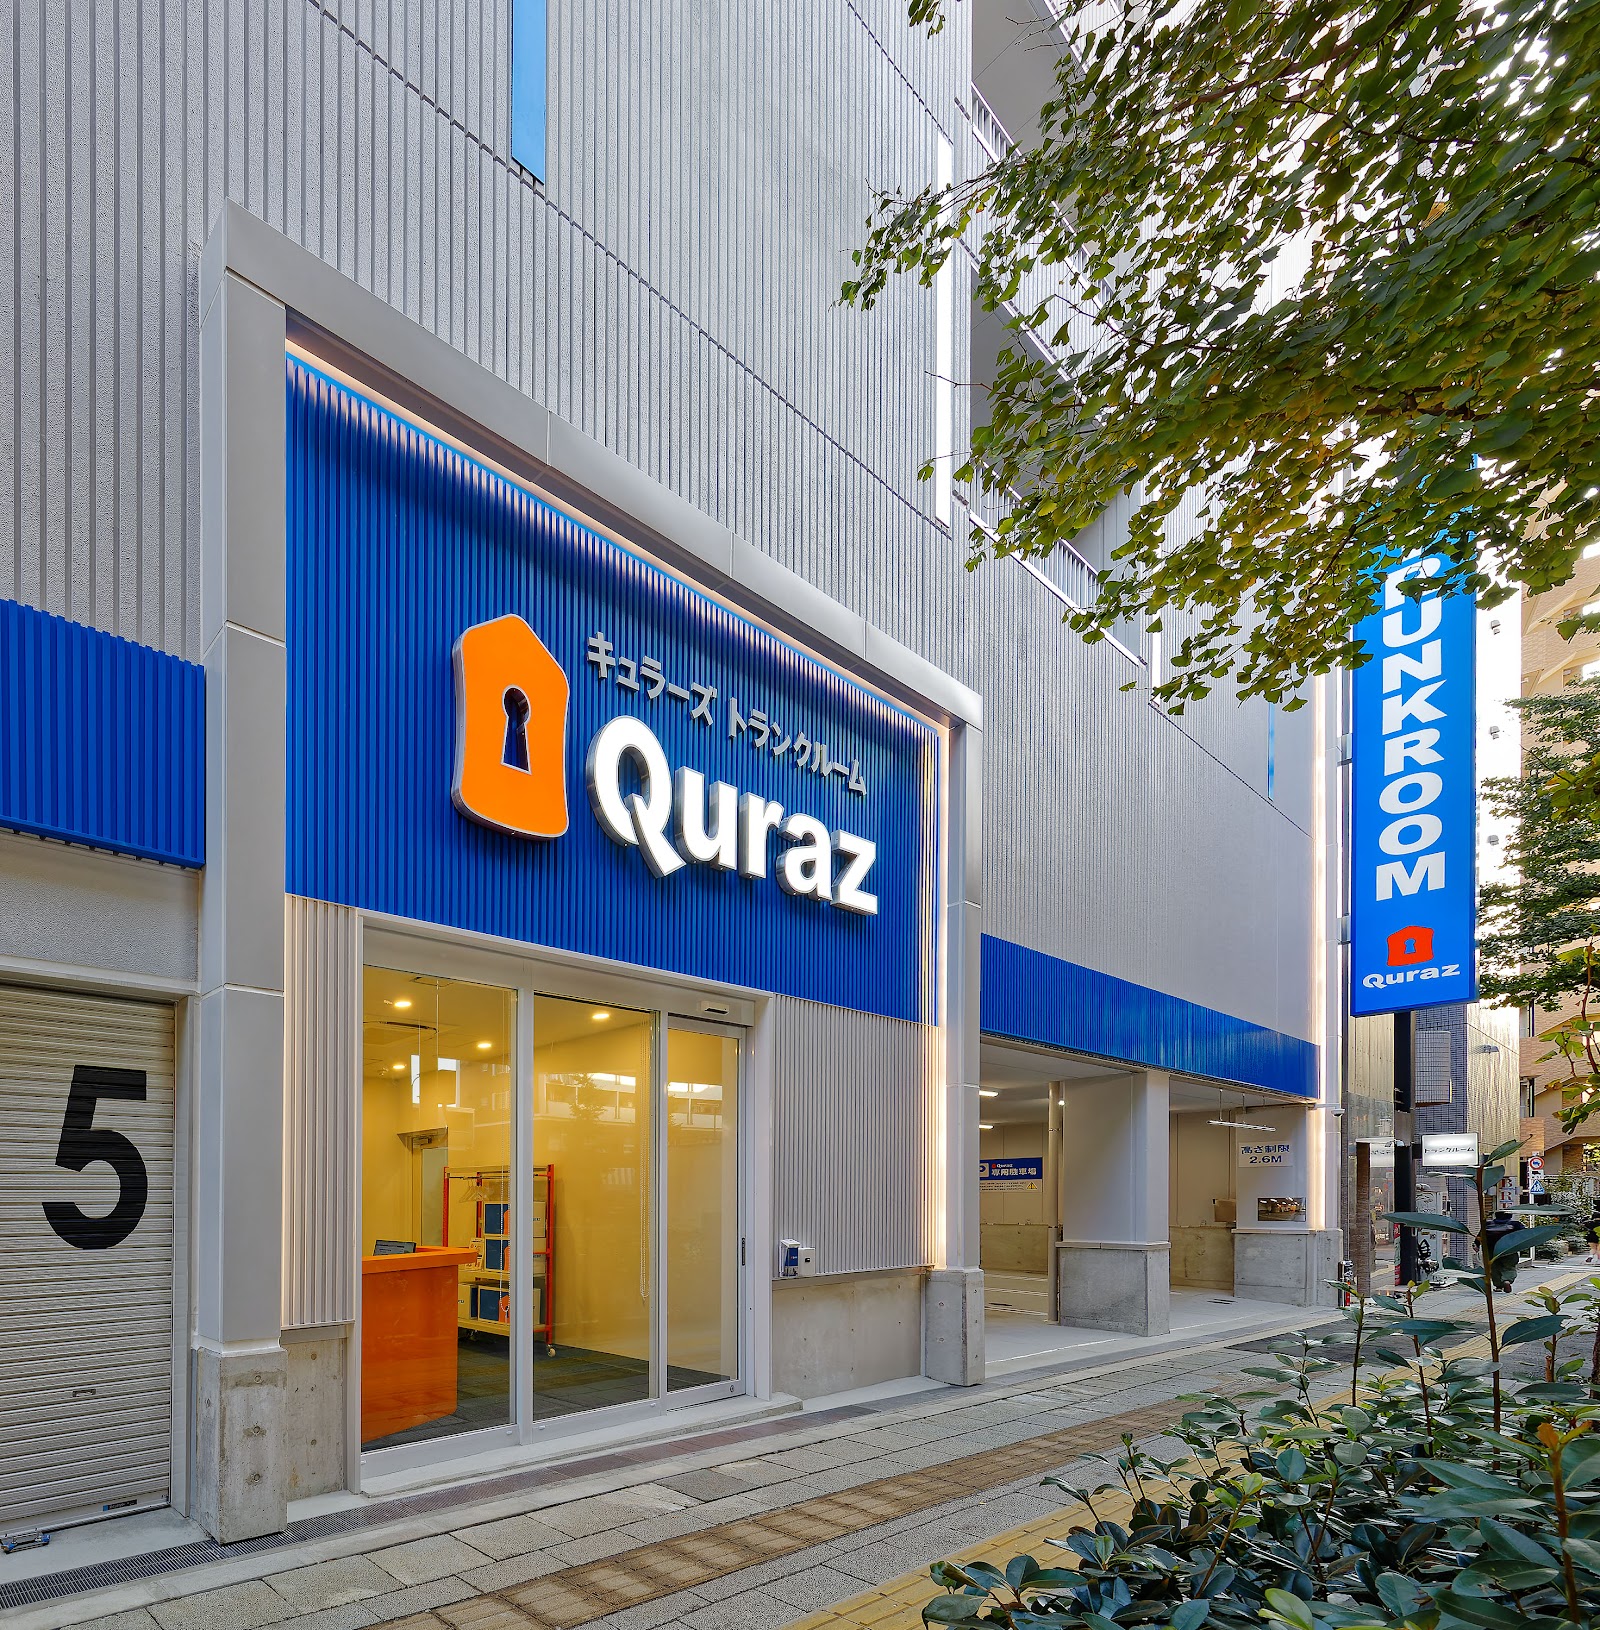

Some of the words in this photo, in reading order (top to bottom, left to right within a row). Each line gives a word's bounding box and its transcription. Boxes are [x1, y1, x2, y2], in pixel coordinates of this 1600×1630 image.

[587, 631, 718, 726] キュラーズ
[728, 697, 867, 796] トランクルーム
[1375, 525, 1447, 902] RUNKROOM
[586, 715, 878, 915] Quraz
[1362, 964, 1460, 989] Quraz
[43, 1066, 148, 1250] 5
[1241, 1144, 1290, 1154] 高さ制限
[1249, 1155, 1282, 1163] 2.6M
